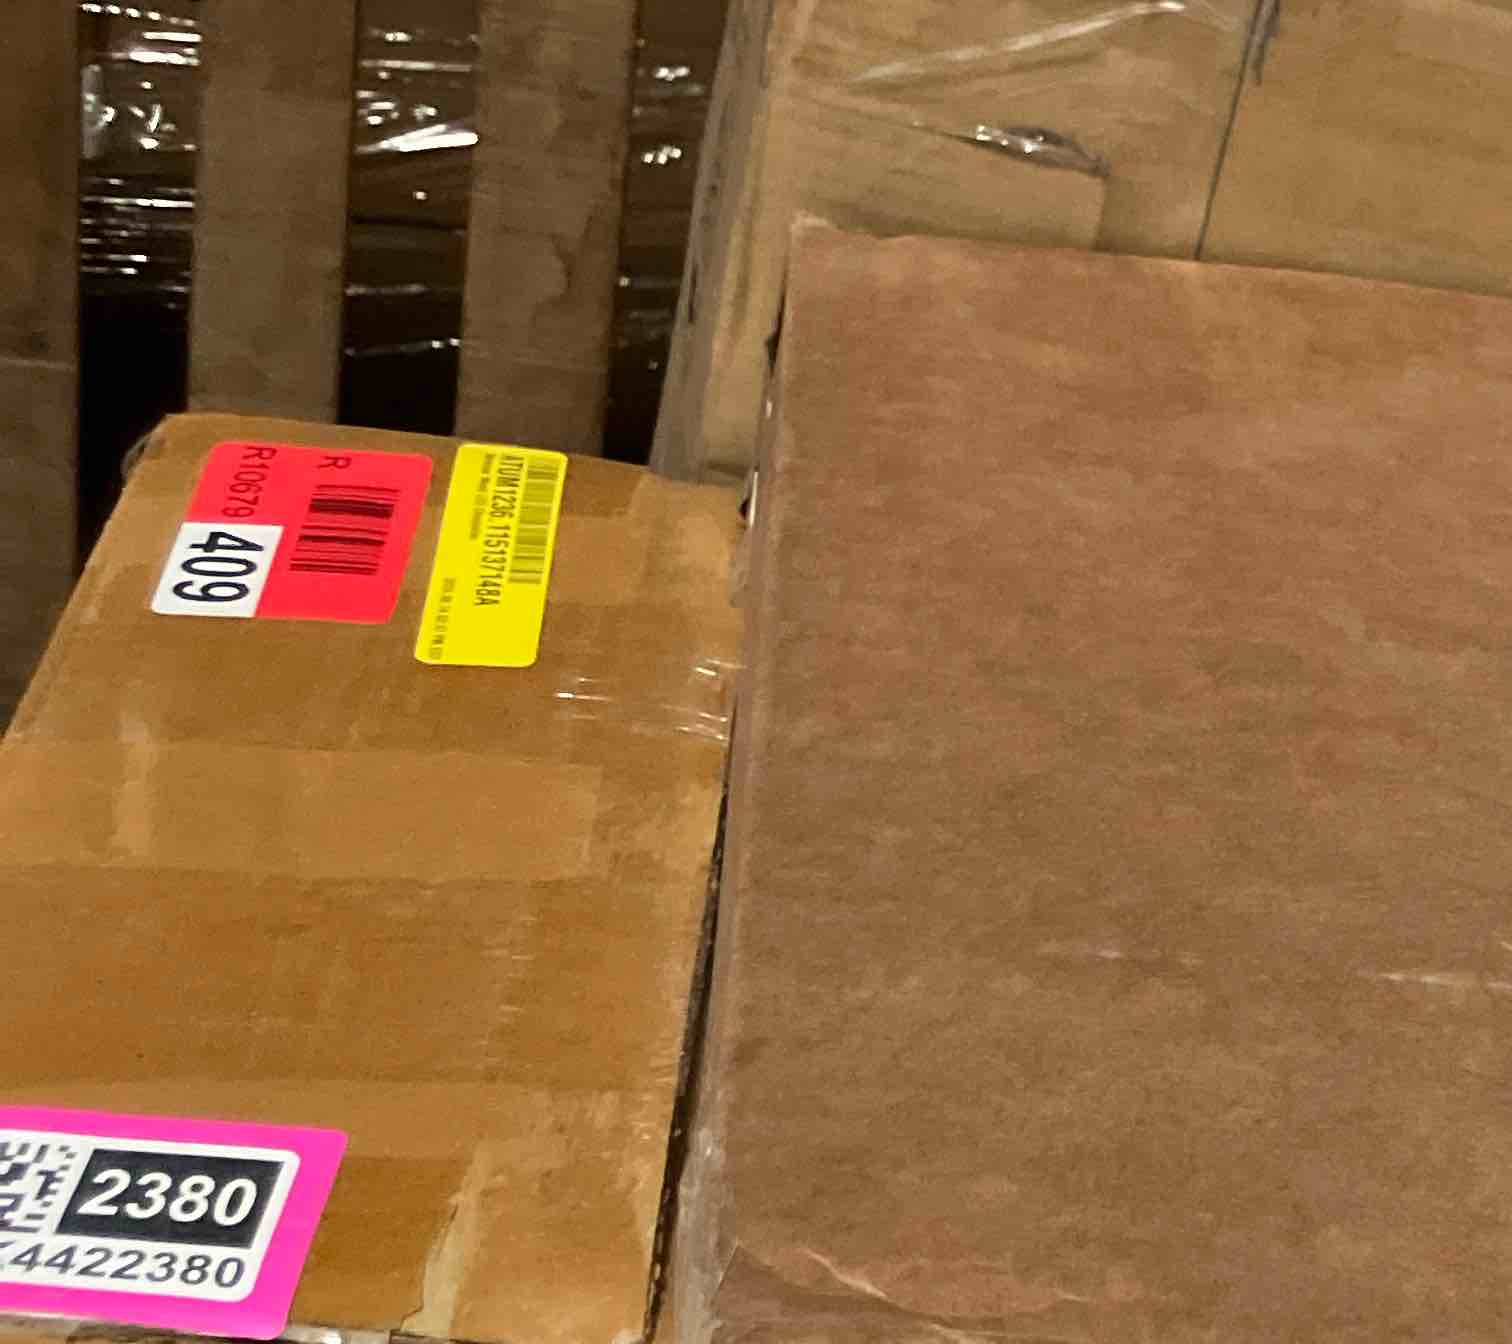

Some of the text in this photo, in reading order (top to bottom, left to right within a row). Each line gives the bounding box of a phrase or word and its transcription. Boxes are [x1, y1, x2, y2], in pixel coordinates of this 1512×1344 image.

[221, 445, 278, 519] R10679
[320, 455, 352, 471] R
[172, 529, 265, 603] 409
[77, 1169, 258, 1227] 2380
